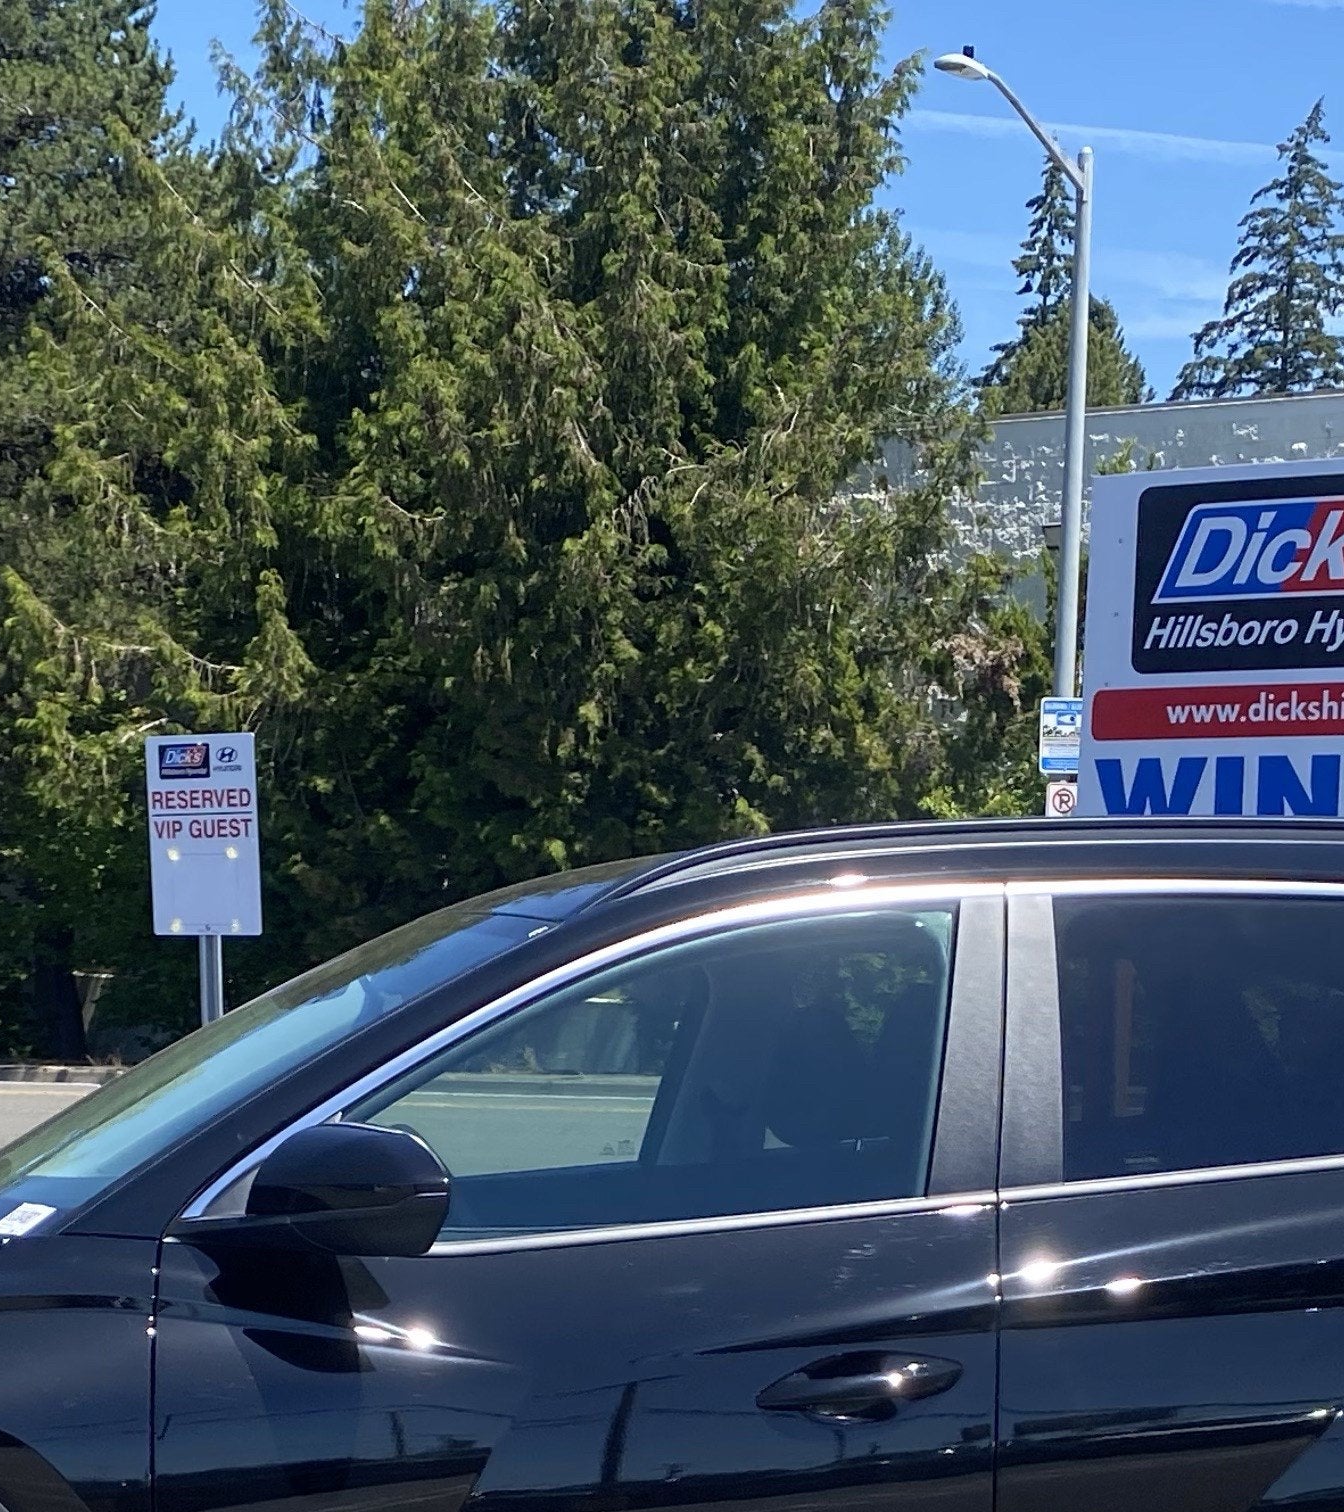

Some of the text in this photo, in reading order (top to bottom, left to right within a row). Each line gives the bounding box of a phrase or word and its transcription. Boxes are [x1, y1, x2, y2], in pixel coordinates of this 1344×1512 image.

[1143, 614, 1299, 650] Hillsboro
[151, 788, 251, 810] RESERVED
[154, 818, 252, 839] VIP GUEST
